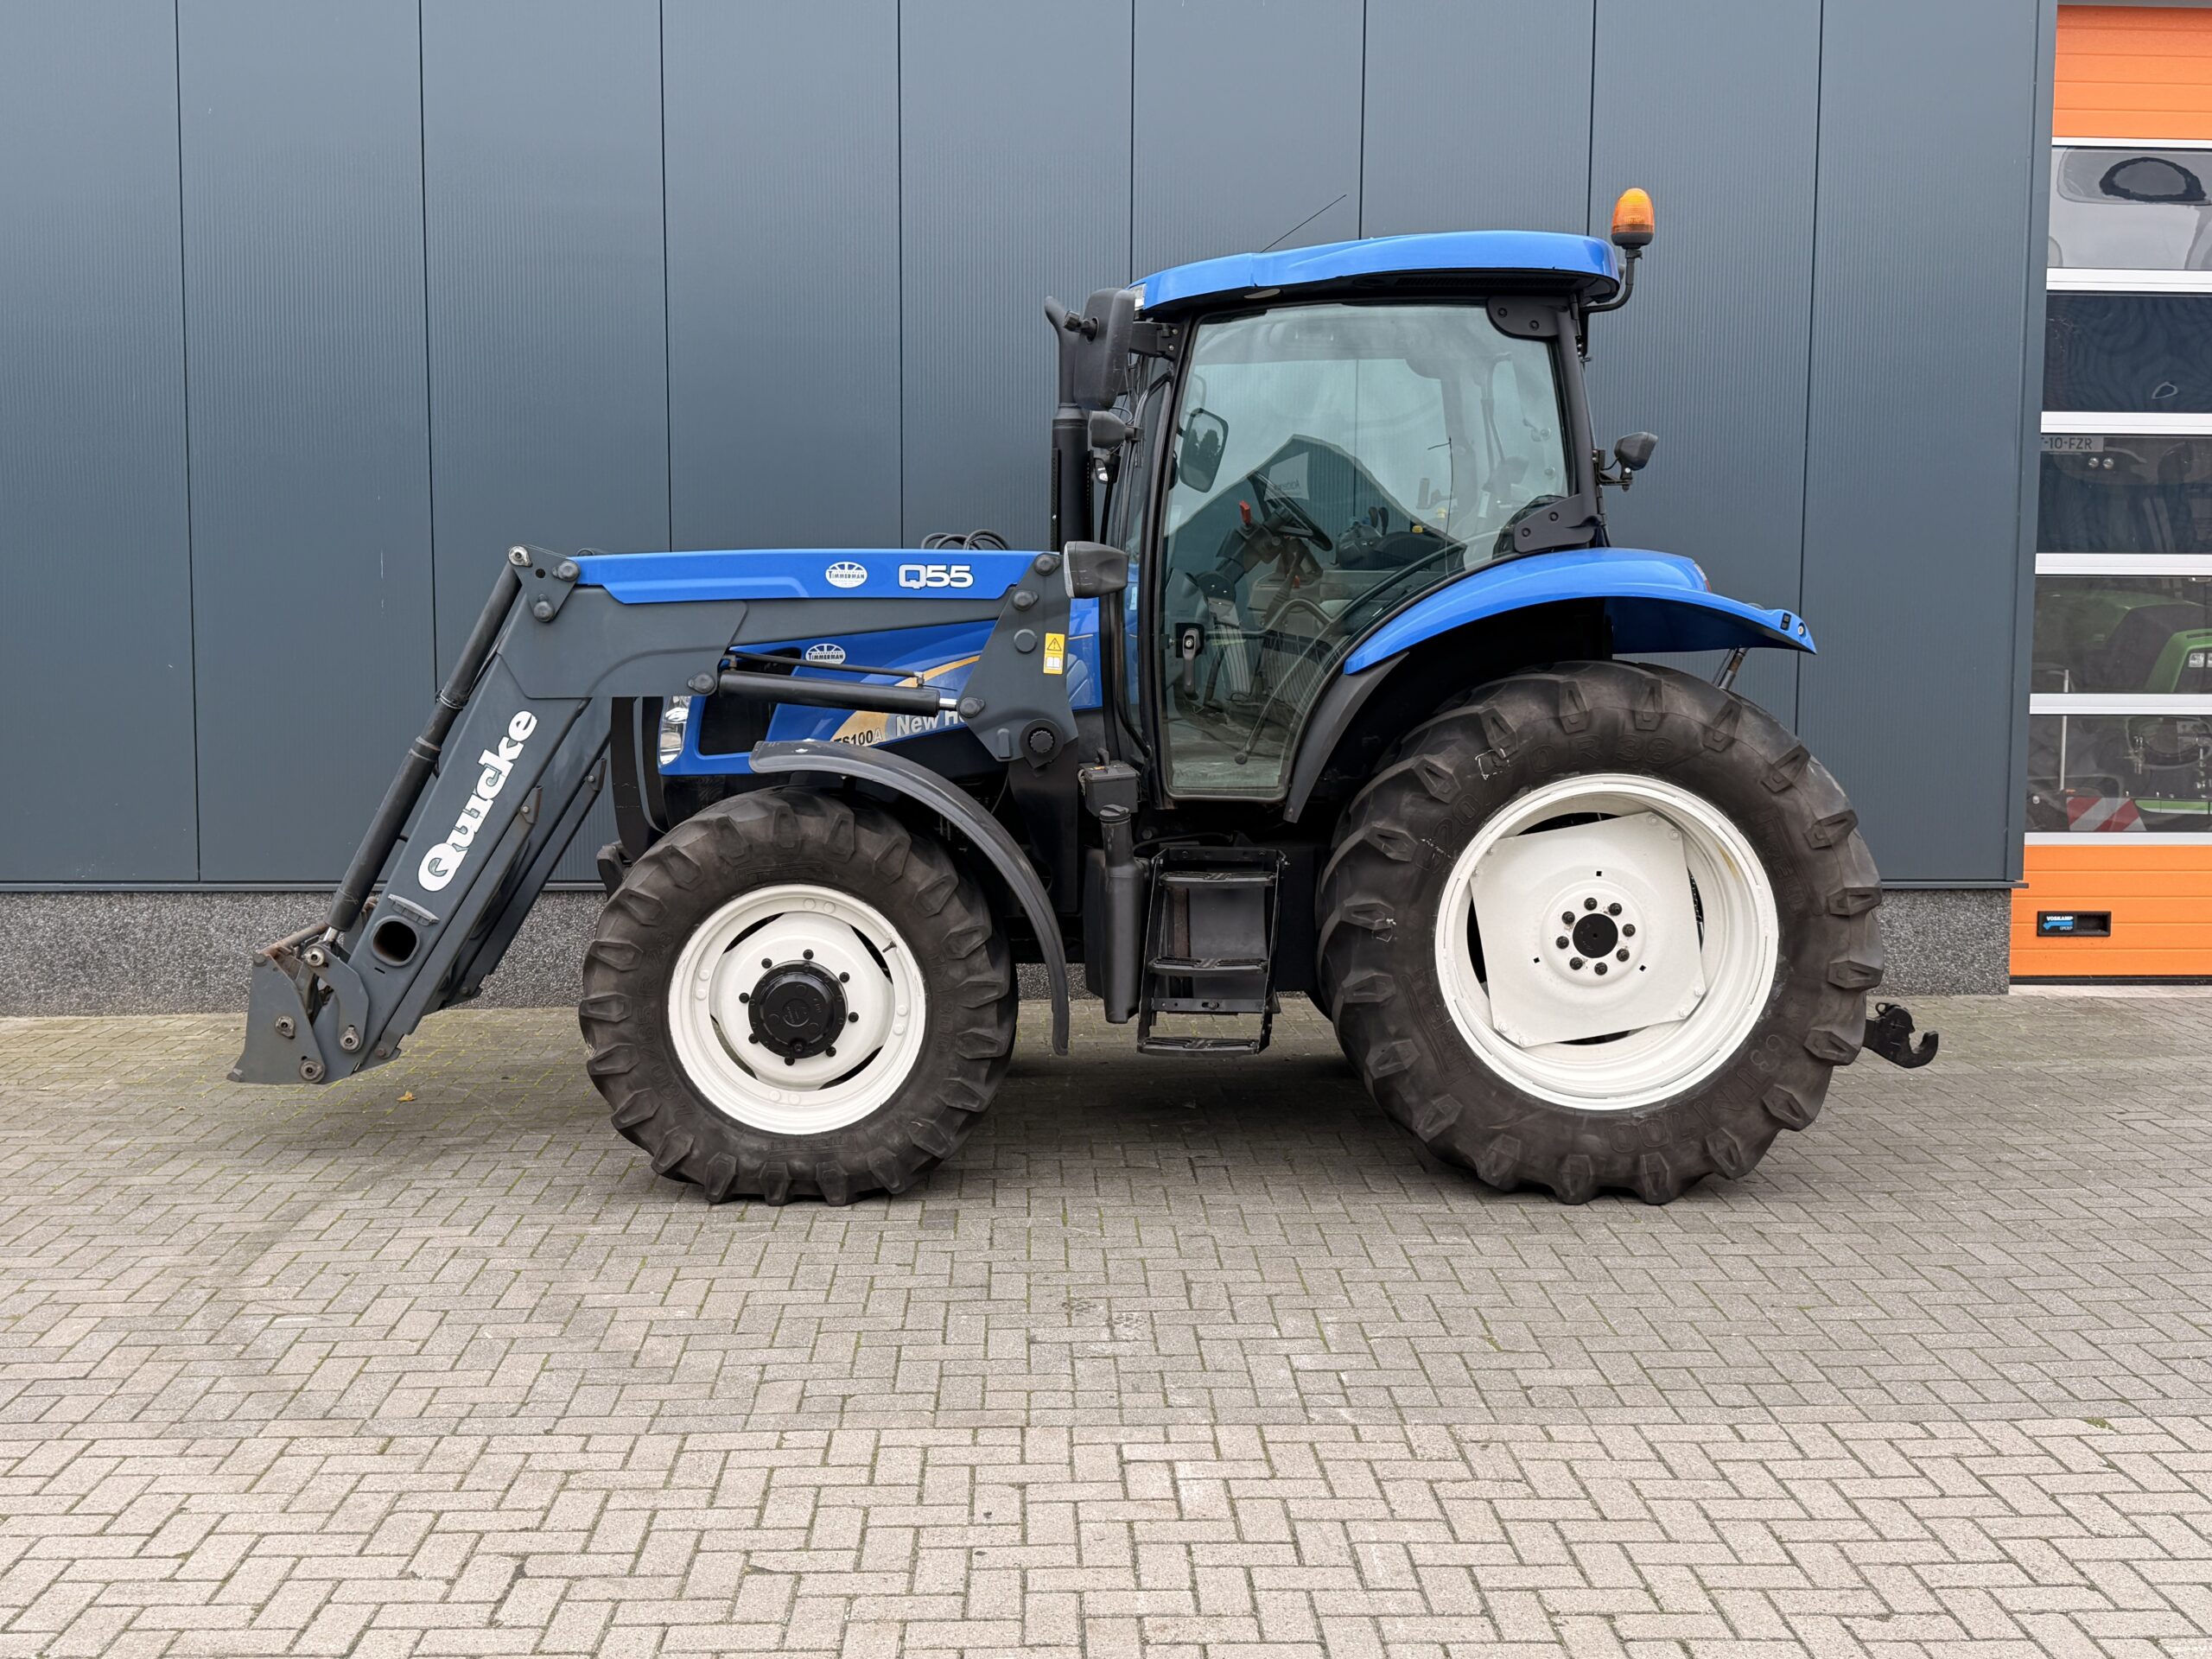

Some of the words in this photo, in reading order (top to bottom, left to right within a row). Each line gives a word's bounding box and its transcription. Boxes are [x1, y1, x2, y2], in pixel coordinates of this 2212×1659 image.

[828, 570, 865, 579] TIMMERMAN
[898, 564, 974, 589] Q55
[833, 727, 883, 746] S100A
[896, 714, 939, 737] New
[1616, 734, 1674, 765] 38
[417, 710, 538, 892] Quicke
